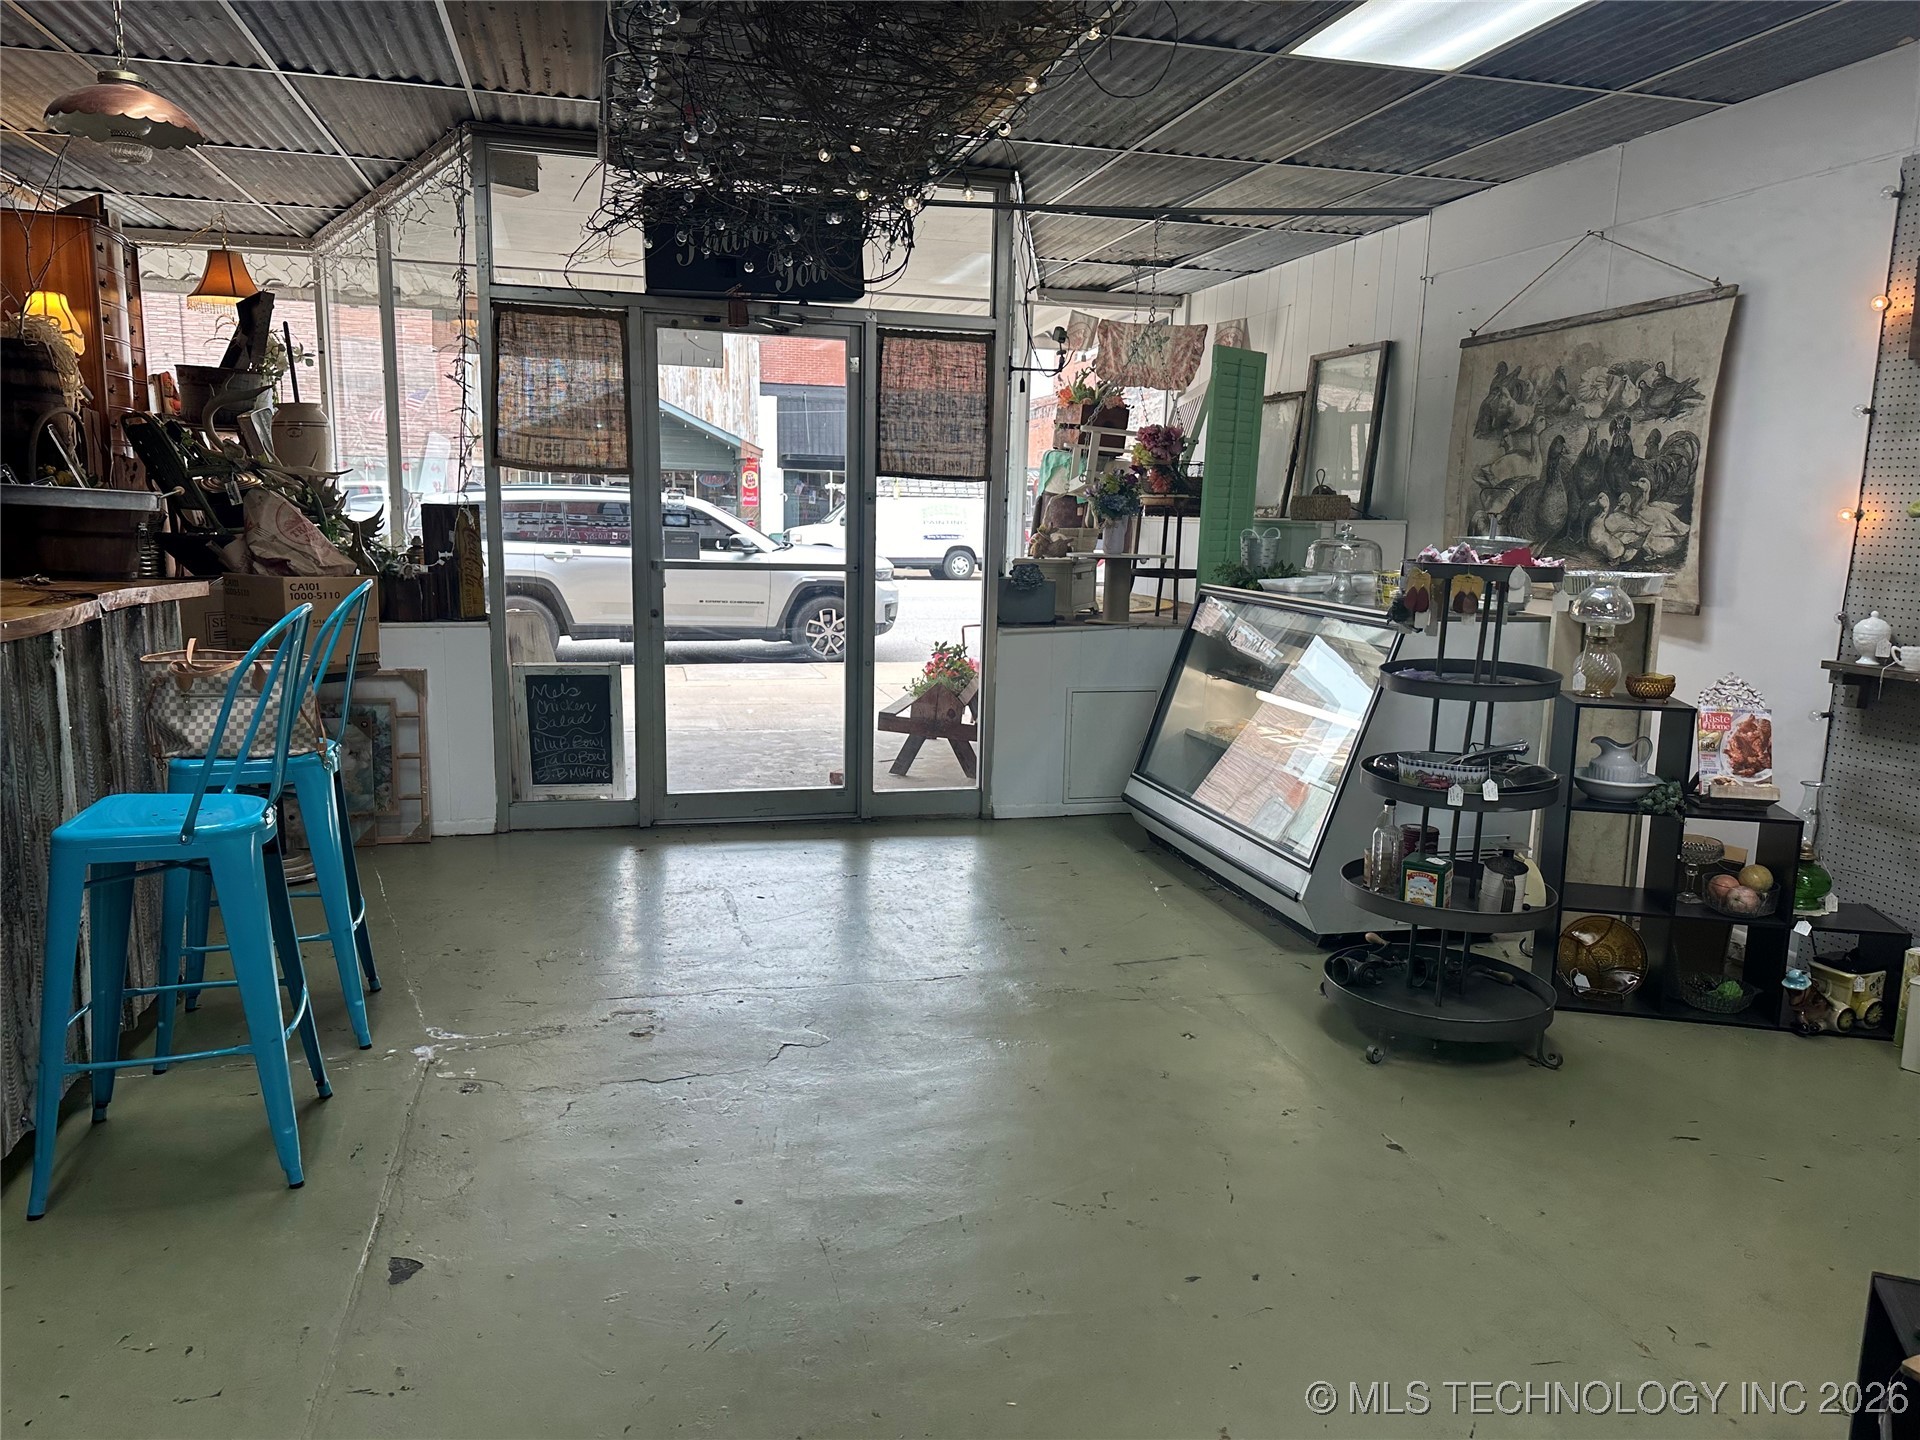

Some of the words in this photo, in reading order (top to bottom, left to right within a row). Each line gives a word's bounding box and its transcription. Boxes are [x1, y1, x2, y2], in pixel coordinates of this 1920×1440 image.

[289, 582, 320, 592] CA101
[289, 591, 341, 600] 1000-5110
[536, 699, 597, 715] Chicken
[536, 713, 592, 730] Salad
[1702, 713, 1730, 724] Taste
[1706, 722, 1730, 730] Home
